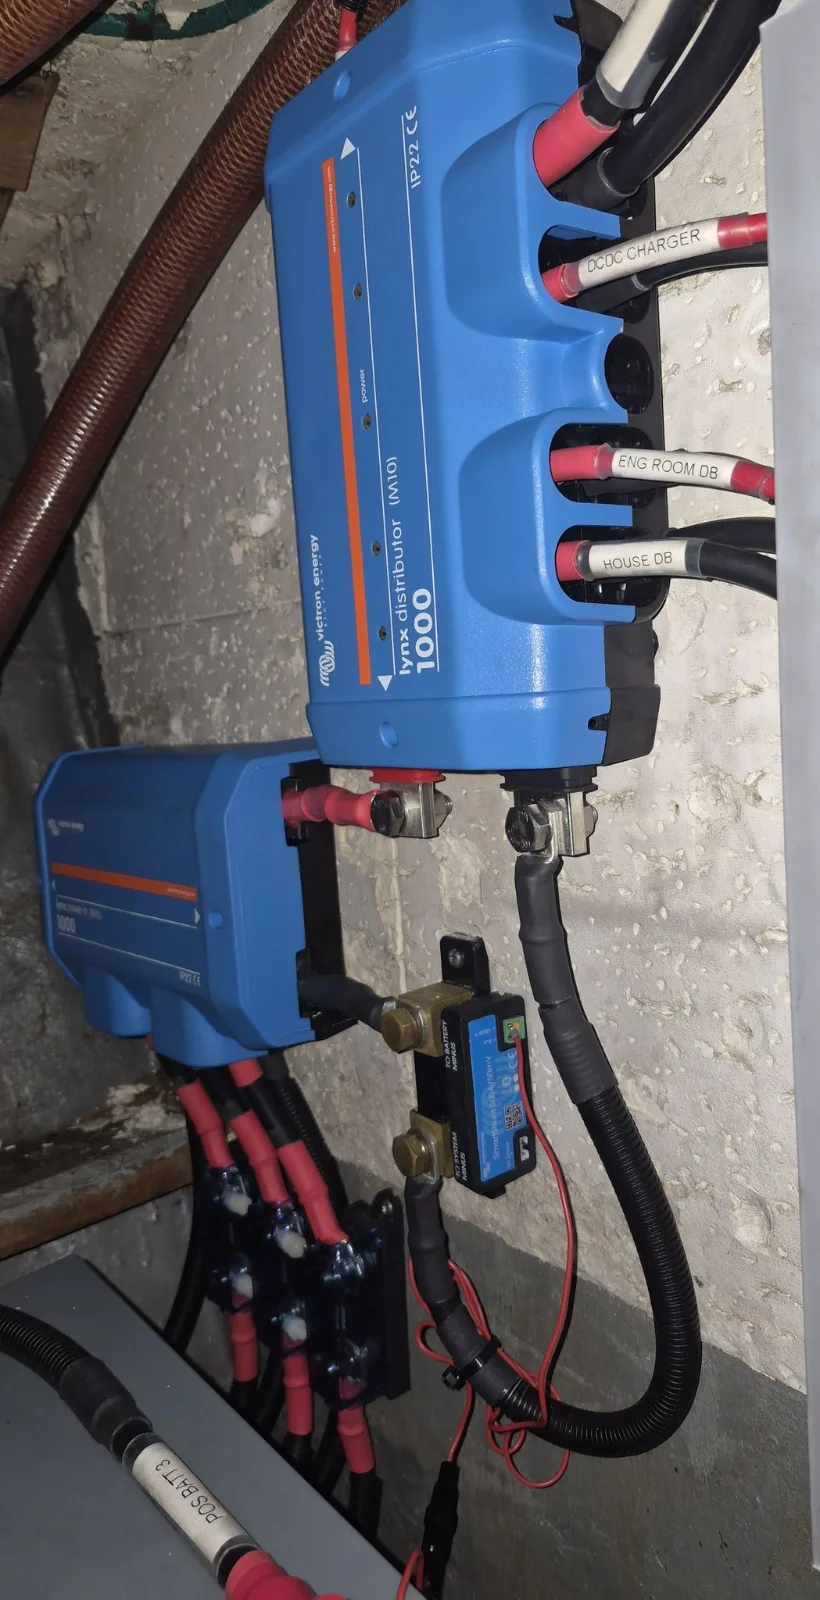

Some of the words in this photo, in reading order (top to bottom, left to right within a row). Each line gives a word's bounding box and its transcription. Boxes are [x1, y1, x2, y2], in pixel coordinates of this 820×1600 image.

[408, 140, 421, 189] IP22
[587, 251, 624, 273] DCDC
[626, 228, 701, 260] CHARGER
[359, 369, 369, 404] power
[385, 456, 401, 506] (M10)
[618, 454, 648, 470] ENG
[651, 458, 695, 476] ROOM
[699, 464, 719, 480] DB
[310, 534, 320, 586] energy
[391, 519, 408, 622] distributor
[603, 554, 650, 571] HOUSE
[653, 551, 673, 566] DB
[314, 590, 325, 641] victron
[412, 588, 436, 674] 1000
[399, 628, 413, 675] lynx
[56, 914, 76, 934] 1000
[441, 1020, 450, 1054] BATTERY
[444, 1054, 452, 1068] TO
[450, 1041, 458, 1071] MINUS
[451, 1131, 460, 1164] SYSTEM
[489, 1109, 500, 1161] SmartShunt
[454, 1165, 460, 1178] TO
[459, 1151, 468, 1181] MINUS
[155, 1459, 171, 1472] 3
[161, 1468, 199, 1499] BATT
[190, 1495, 224, 1524] POS
